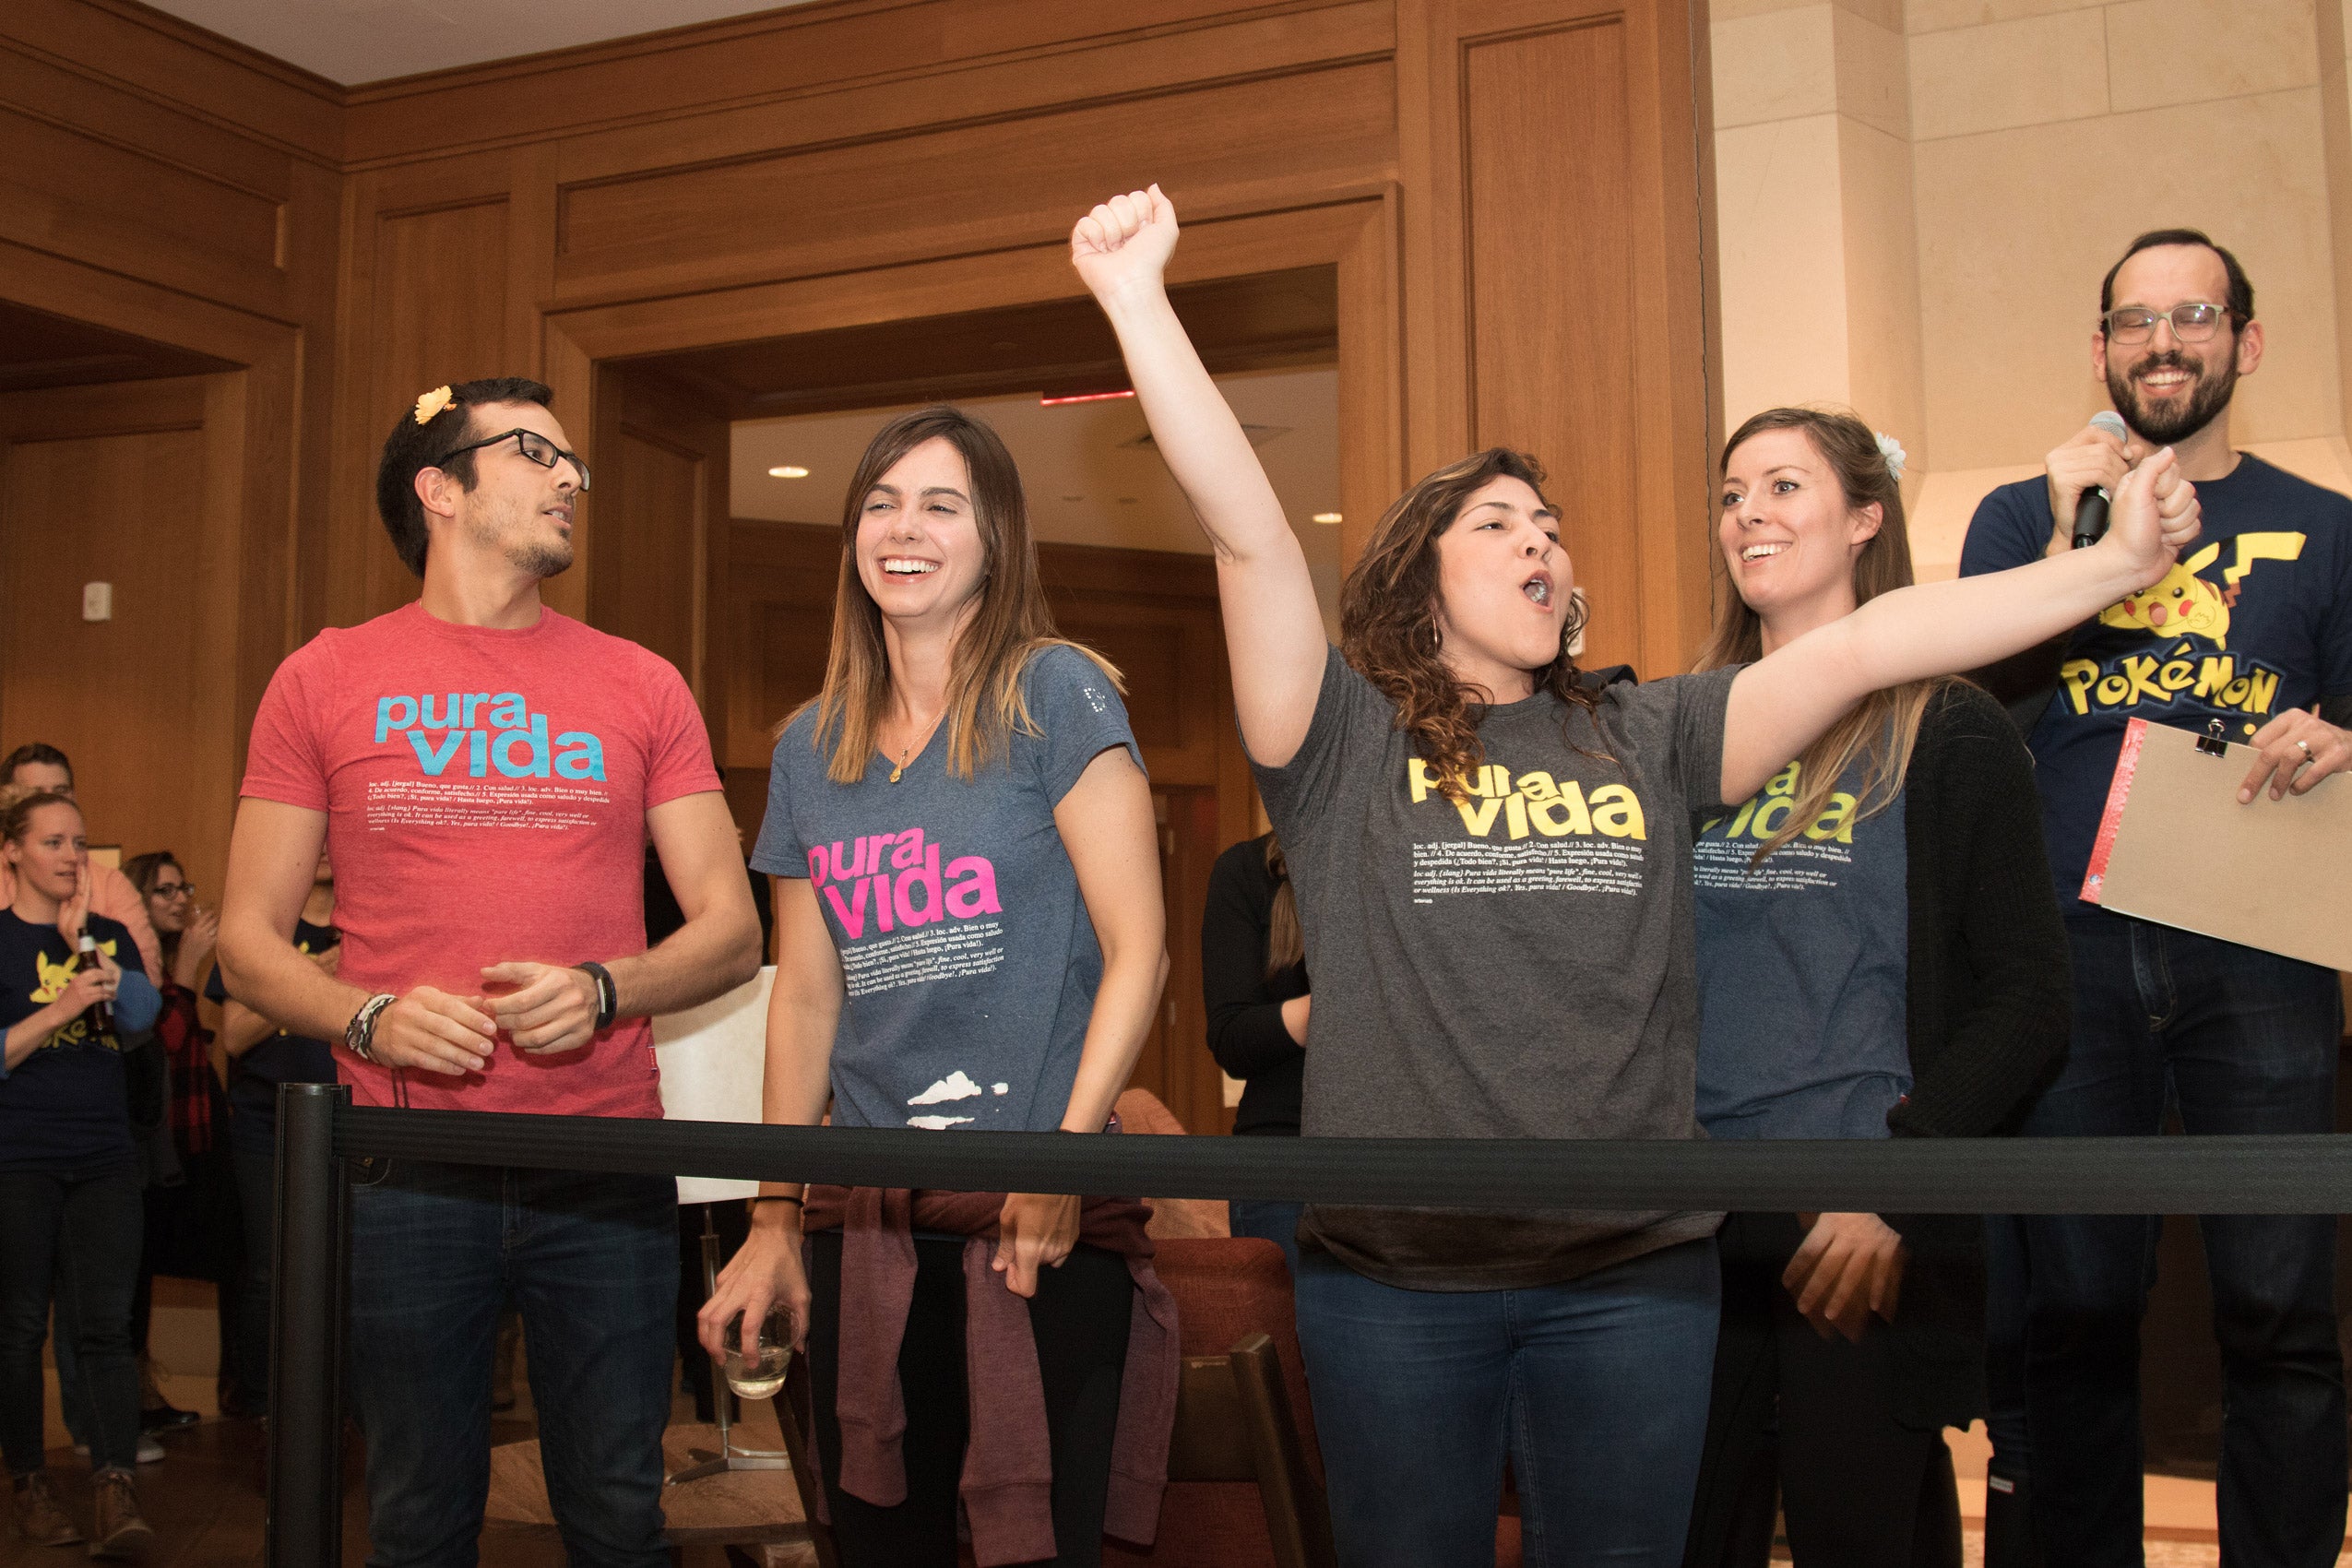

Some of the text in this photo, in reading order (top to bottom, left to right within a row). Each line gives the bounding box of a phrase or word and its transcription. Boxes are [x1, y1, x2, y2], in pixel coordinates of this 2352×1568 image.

[374, 692, 528, 742] pura
[406, 713, 607, 781] vida
[1408, 758, 1561, 803] pura
[1452, 780, 1646, 840] vida
[1702, 792, 1857, 844] ida
[823, 843, 1003, 939] vida
